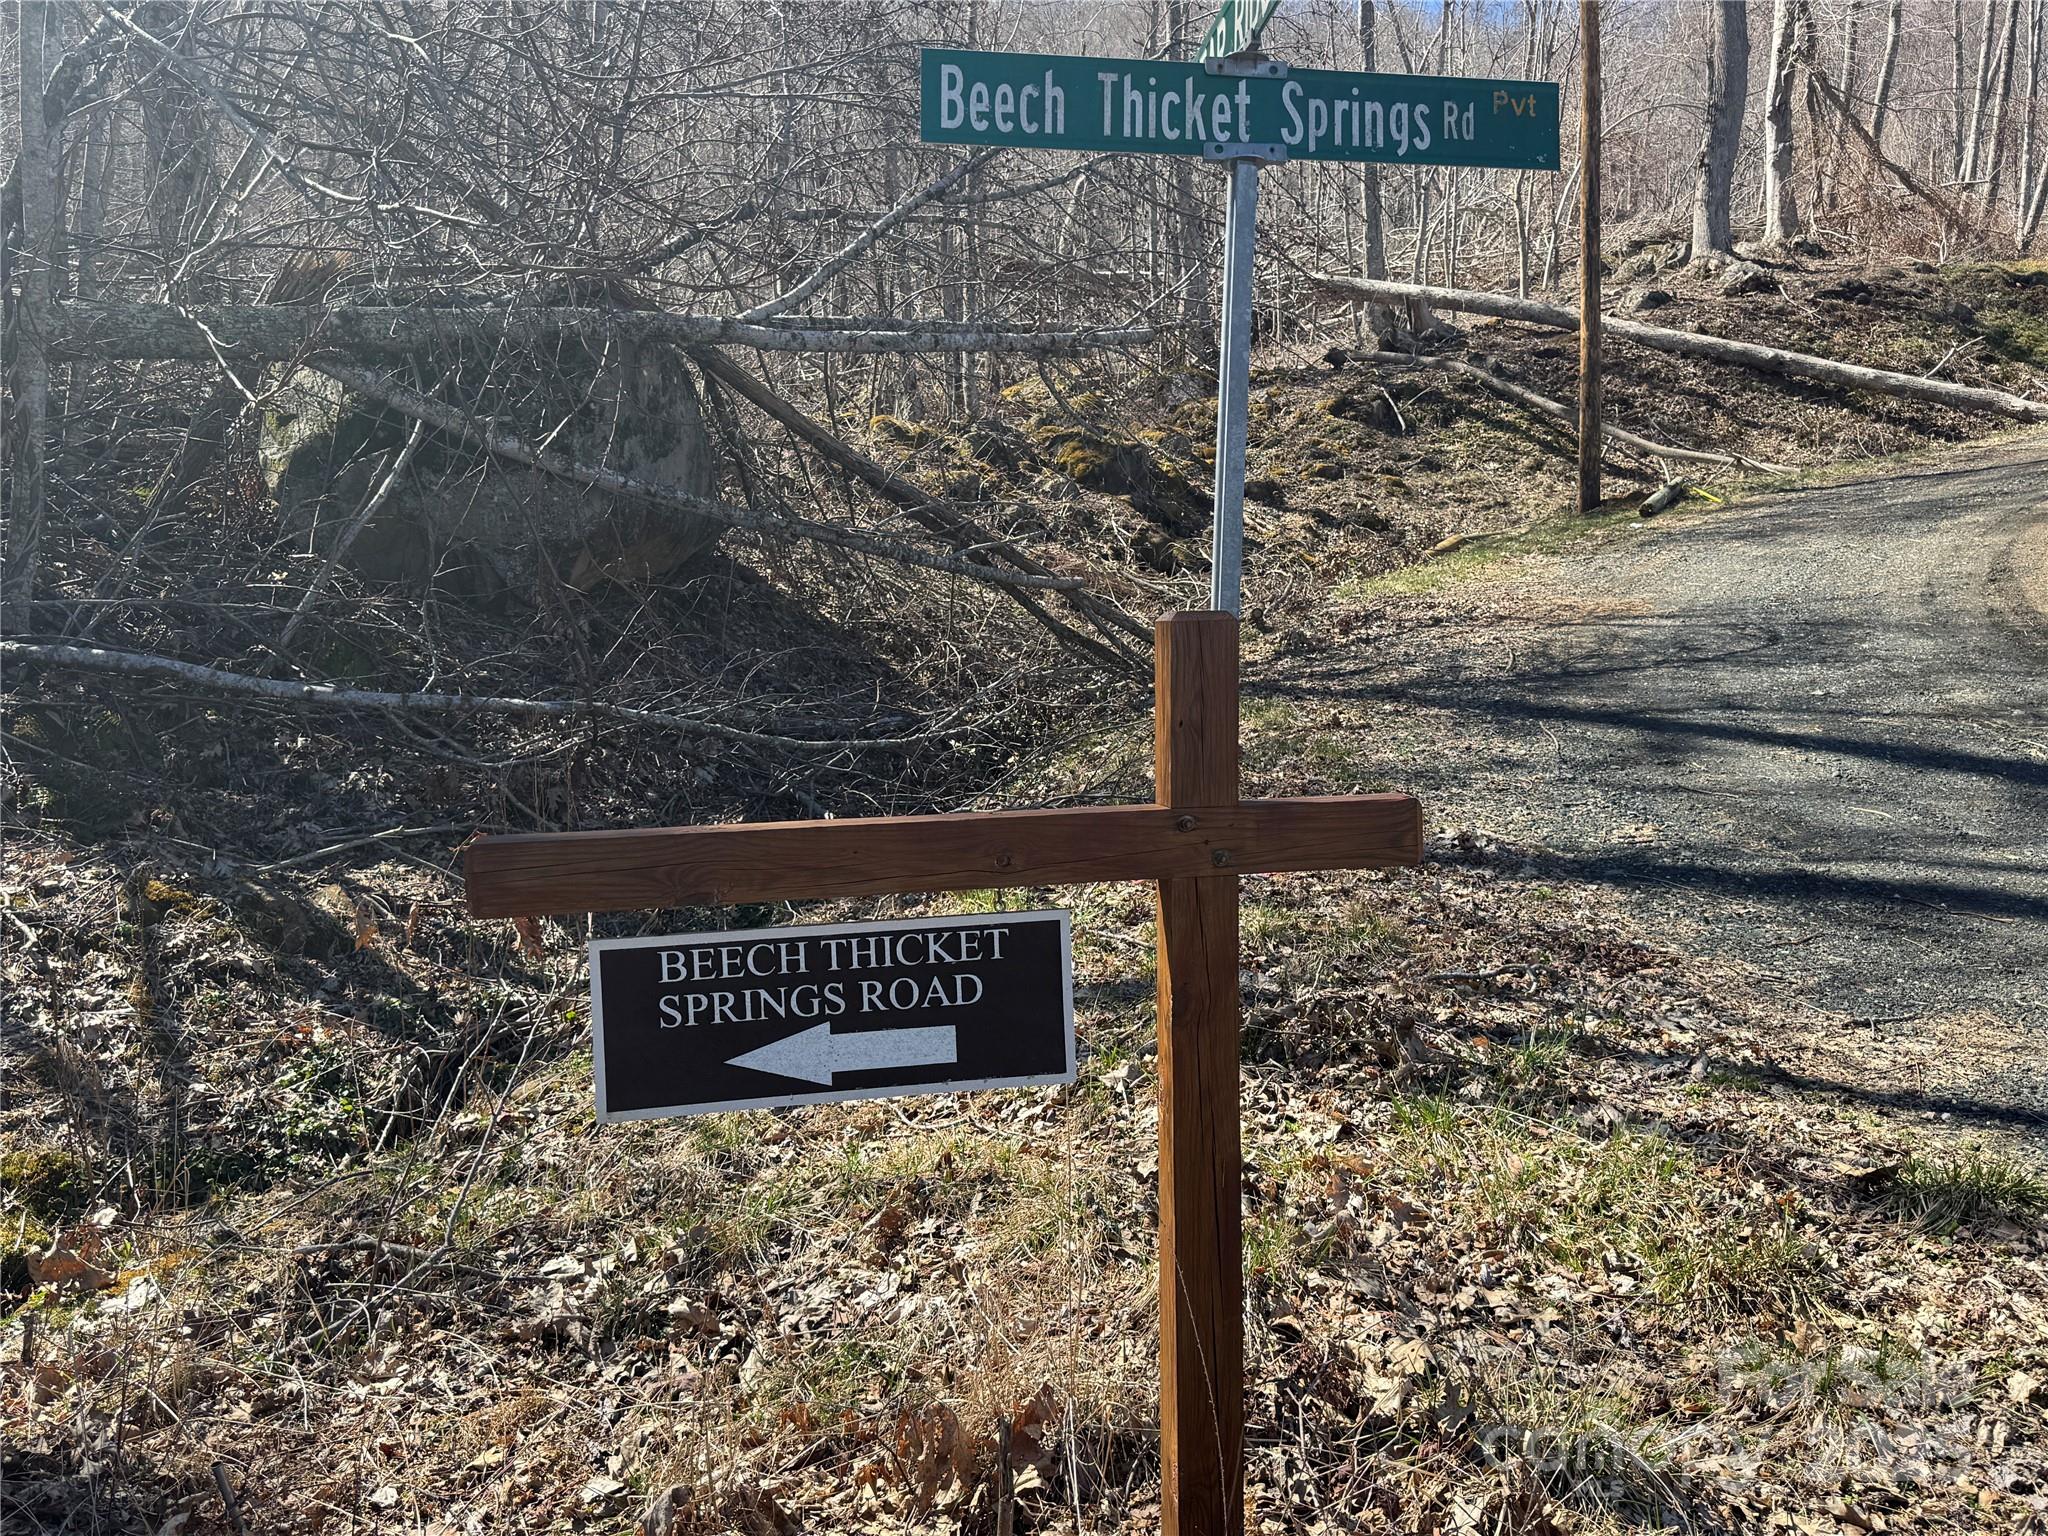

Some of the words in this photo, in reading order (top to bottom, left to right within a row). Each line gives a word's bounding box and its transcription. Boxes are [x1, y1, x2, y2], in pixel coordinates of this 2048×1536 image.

[940, 63, 1065, 135] Beech
[1097, 71, 1251, 143] Thicket
[1280, 80, 1432, 157] Springs
[1443, 100, 1475, 141] Rd
[1492, 91, 1537, 117] Pvt
[656, 940, 808, 984] BEECH
[820, 927, 1009, 971] THICKET
[658, 981, 846, 1029] SPRINGS
[857, 973, 984, 1013] ROAD
